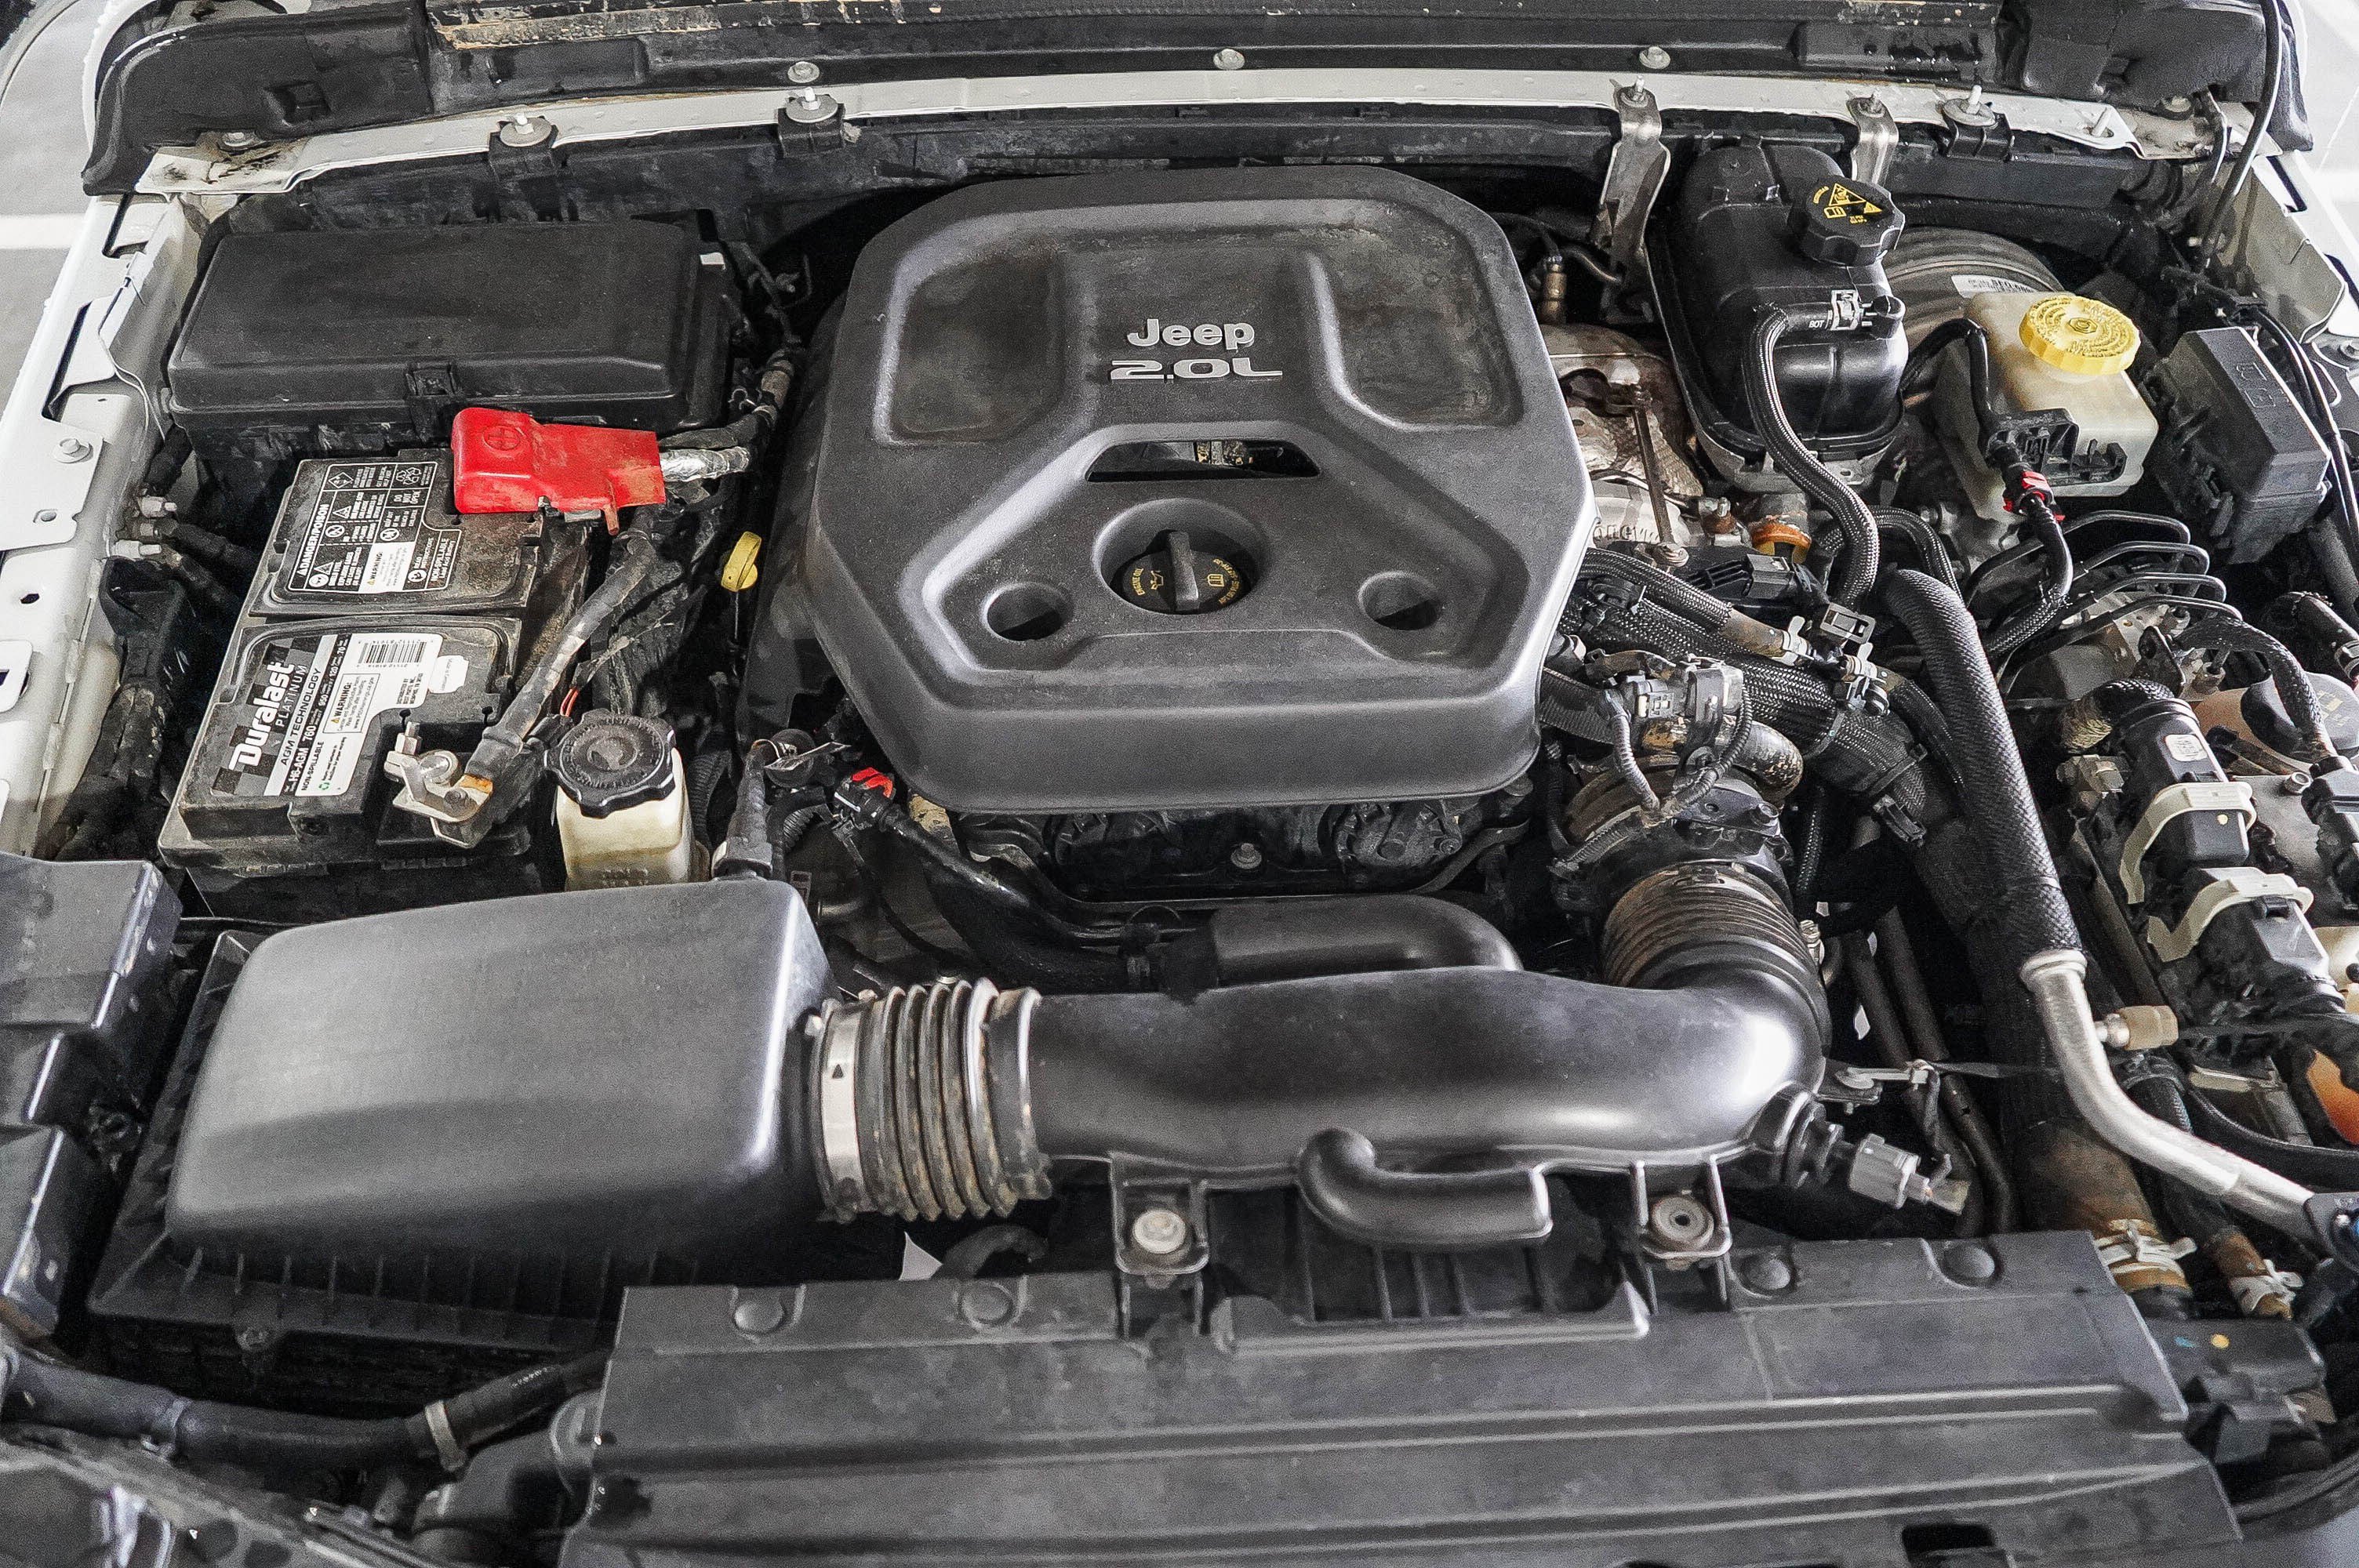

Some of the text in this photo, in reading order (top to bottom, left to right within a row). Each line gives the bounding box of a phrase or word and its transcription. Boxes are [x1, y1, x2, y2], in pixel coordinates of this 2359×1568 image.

[1127, 318, 1255, 350] Jeep
[1110, 357, 1283, 381] 2.0L
[228, 662, 295, 771] Duralast
[275, 664, 307, 728] PLATINUM
[281, 739, 296, 766] AGM
[290, 667, 322, 737] TECHNOLOGY
[335, 682, 352, 719] WARNING:
[288, 747, 309, 782] H6-AGM
[302, 725, 318, 742] 760
